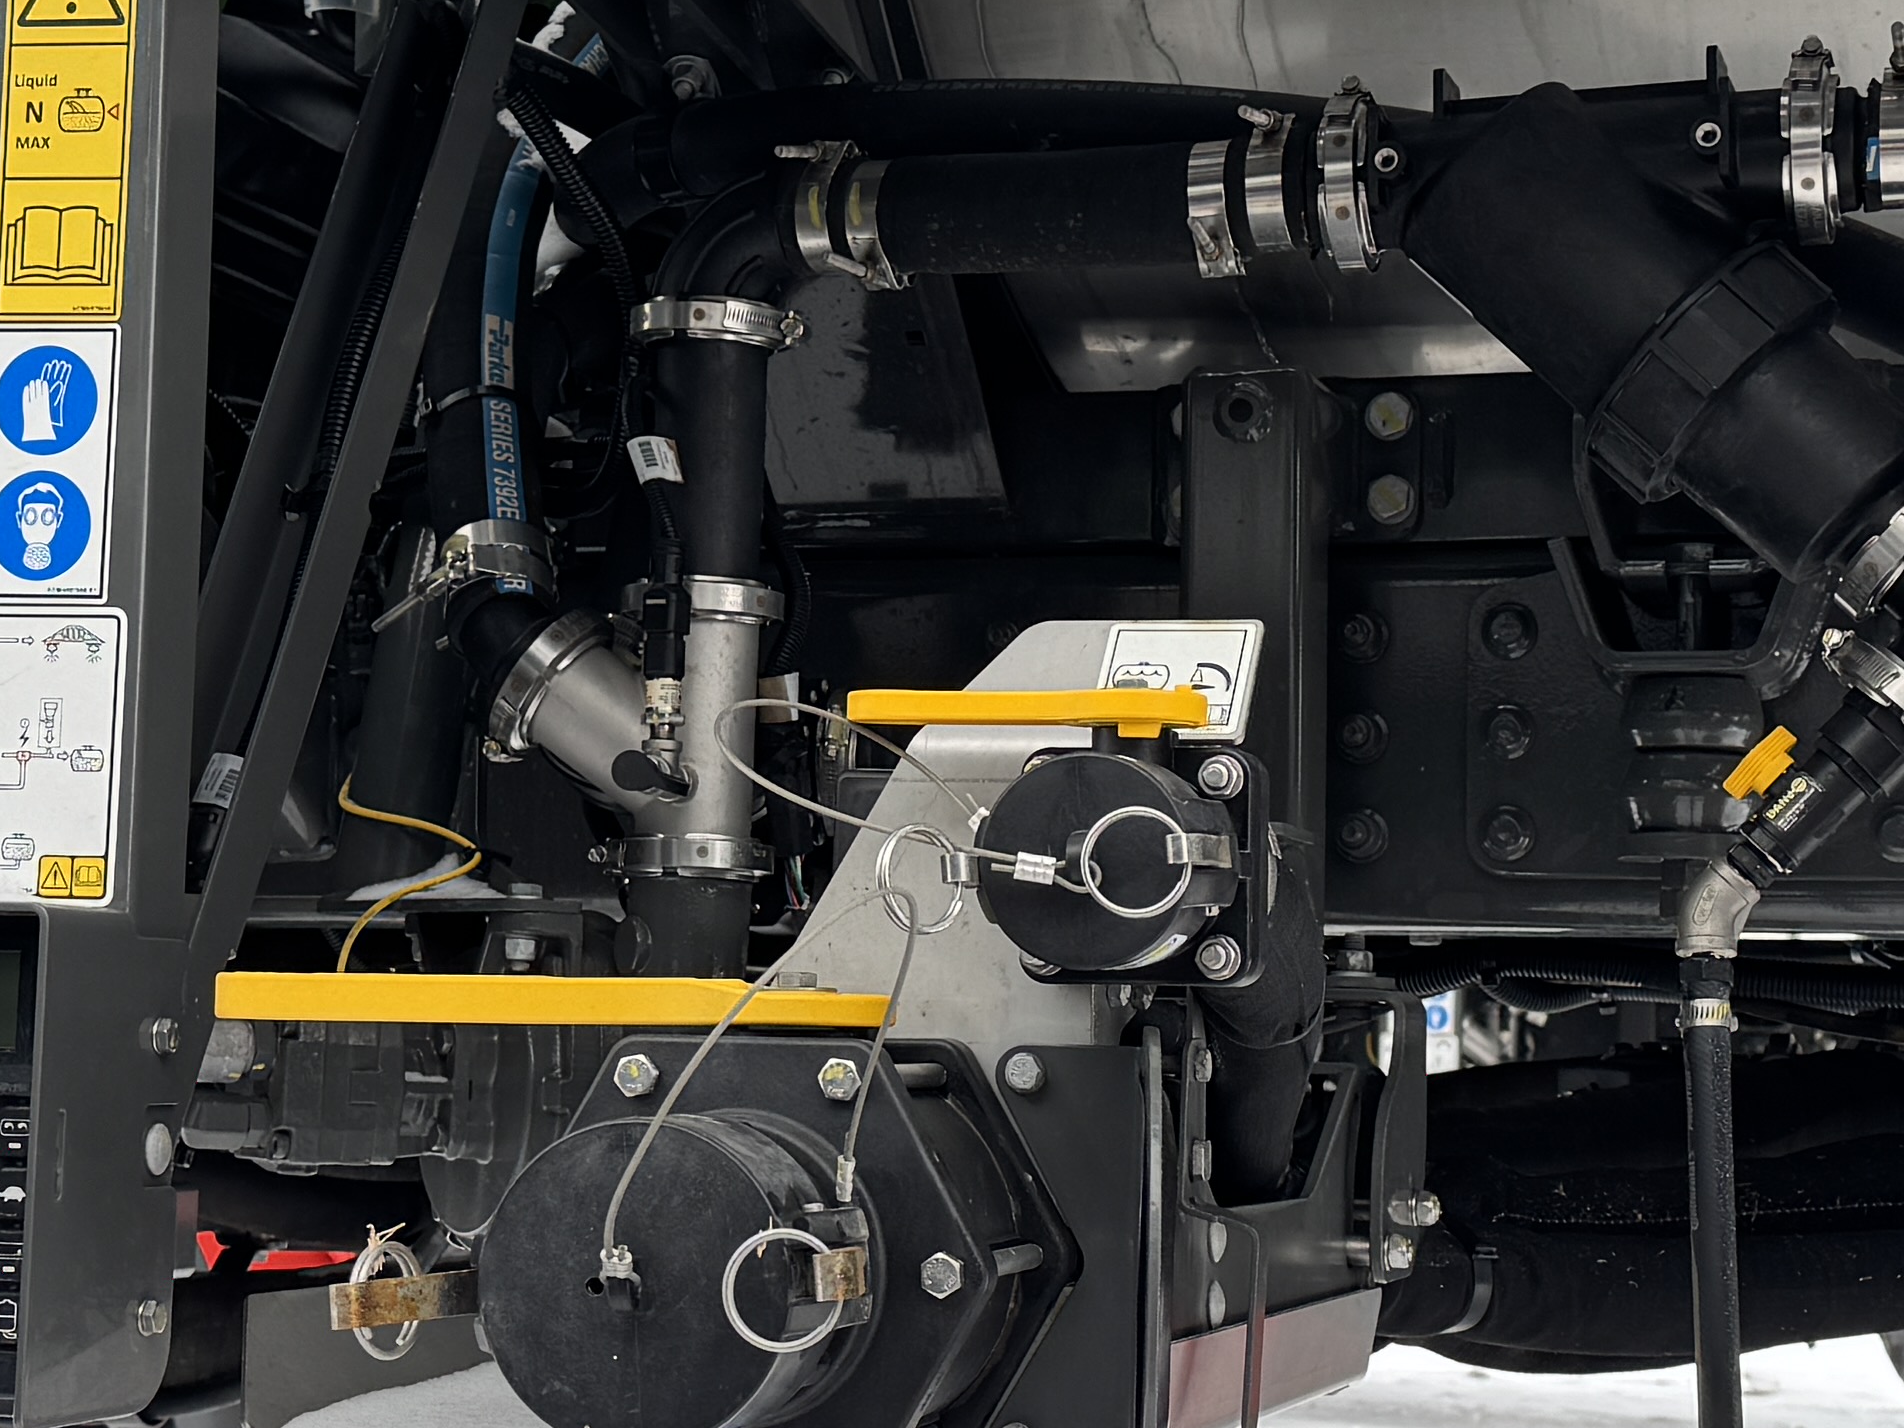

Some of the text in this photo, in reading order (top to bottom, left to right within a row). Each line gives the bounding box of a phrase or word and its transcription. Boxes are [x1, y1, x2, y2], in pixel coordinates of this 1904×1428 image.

[14, 73, 58, 89] Liquid
[25, 101, 45, 124] N
[15, 136, 51, 149] MAX
[486, 329, 512, 385] Parke
[489, 399, 521, 520] SERIES 7392E
